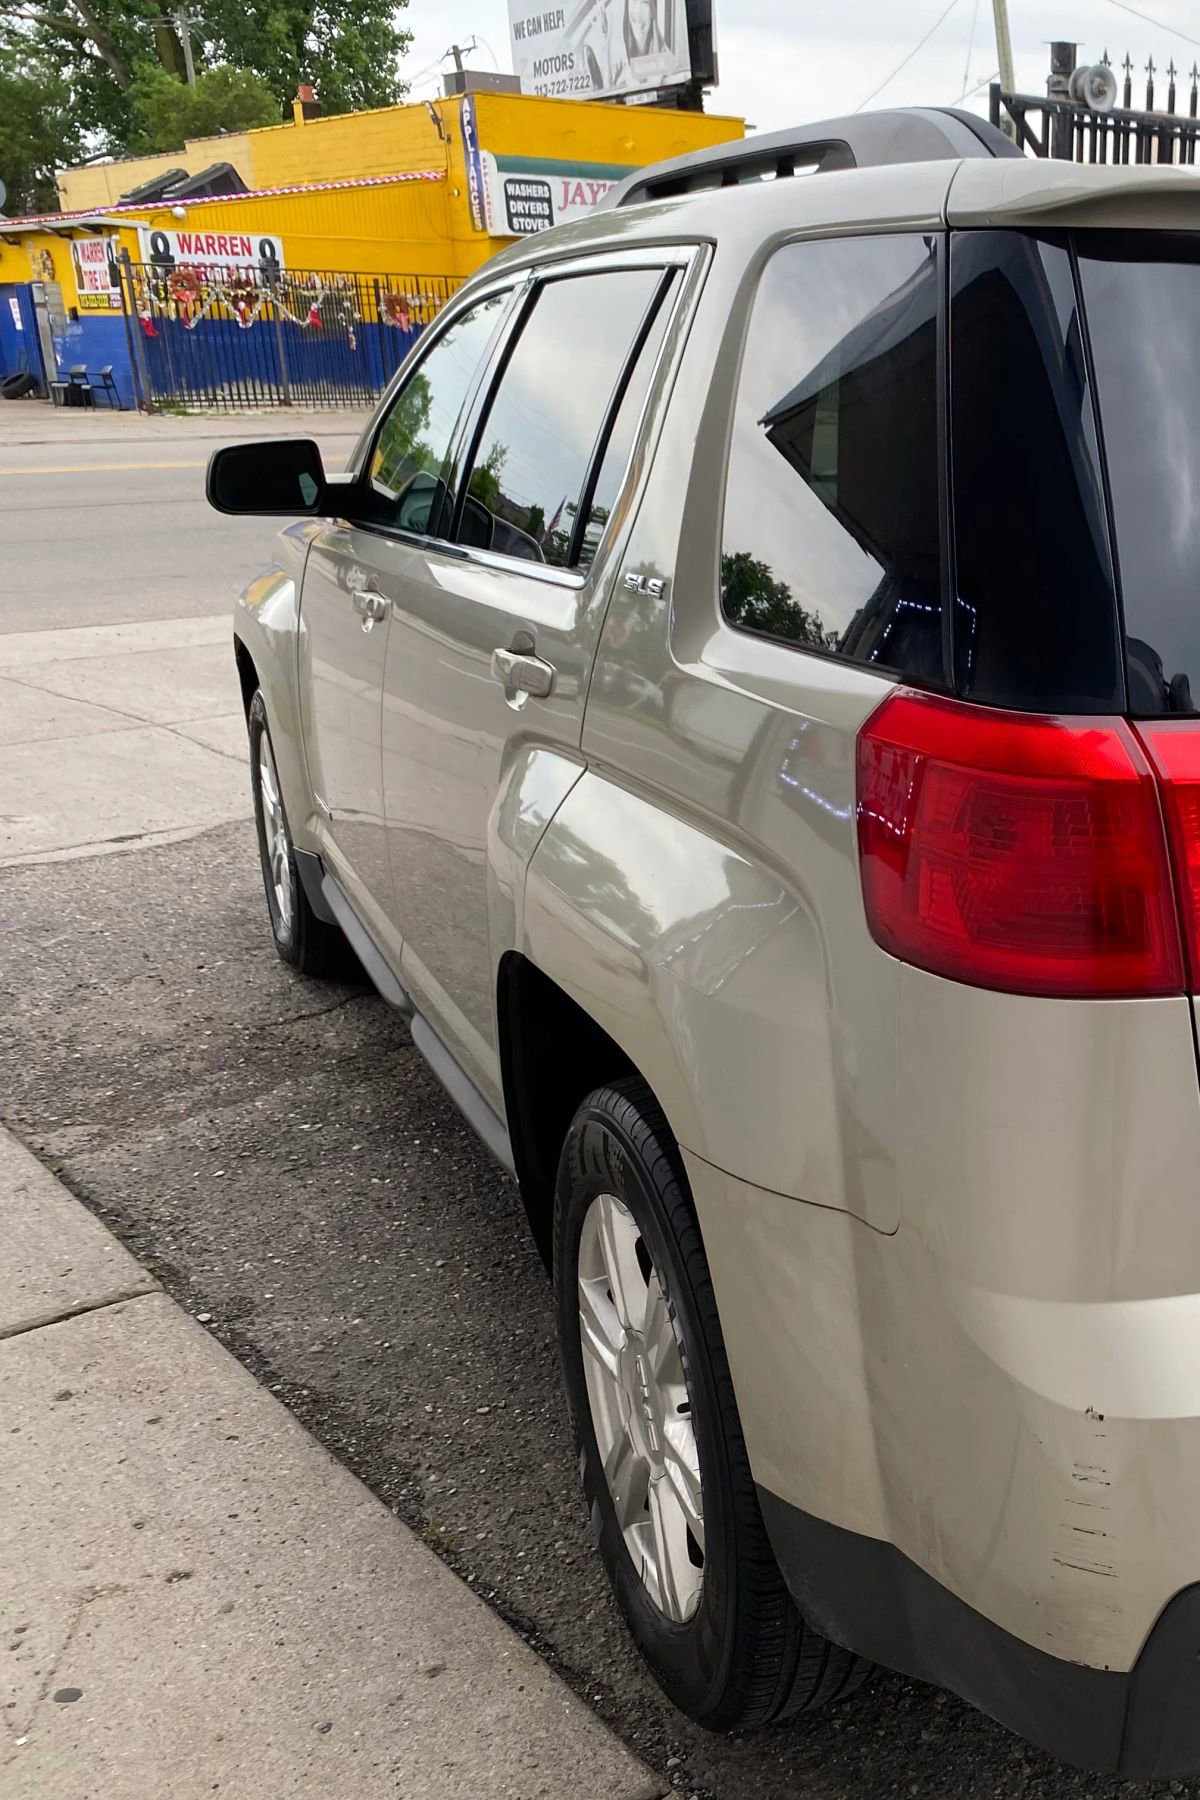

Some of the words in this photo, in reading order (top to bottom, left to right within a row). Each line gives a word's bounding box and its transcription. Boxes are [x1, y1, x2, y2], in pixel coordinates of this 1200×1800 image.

[513, 21, 526, 41] WE
[526, 15, 542, 37] CAN
[543, 9, 565, 33] HELP!
[533, 52, 575, 78] MOTORS
[462, 97, 482, 231] APPLIANCES
[506, 183, 549, 199] WASHERS
[509, 201, 549, 216] DRYERS
[512, 217, 551, 232] STOVES
[80, 242, 105, 264] WARREN
[176, 233, 253, 257] WARREN
